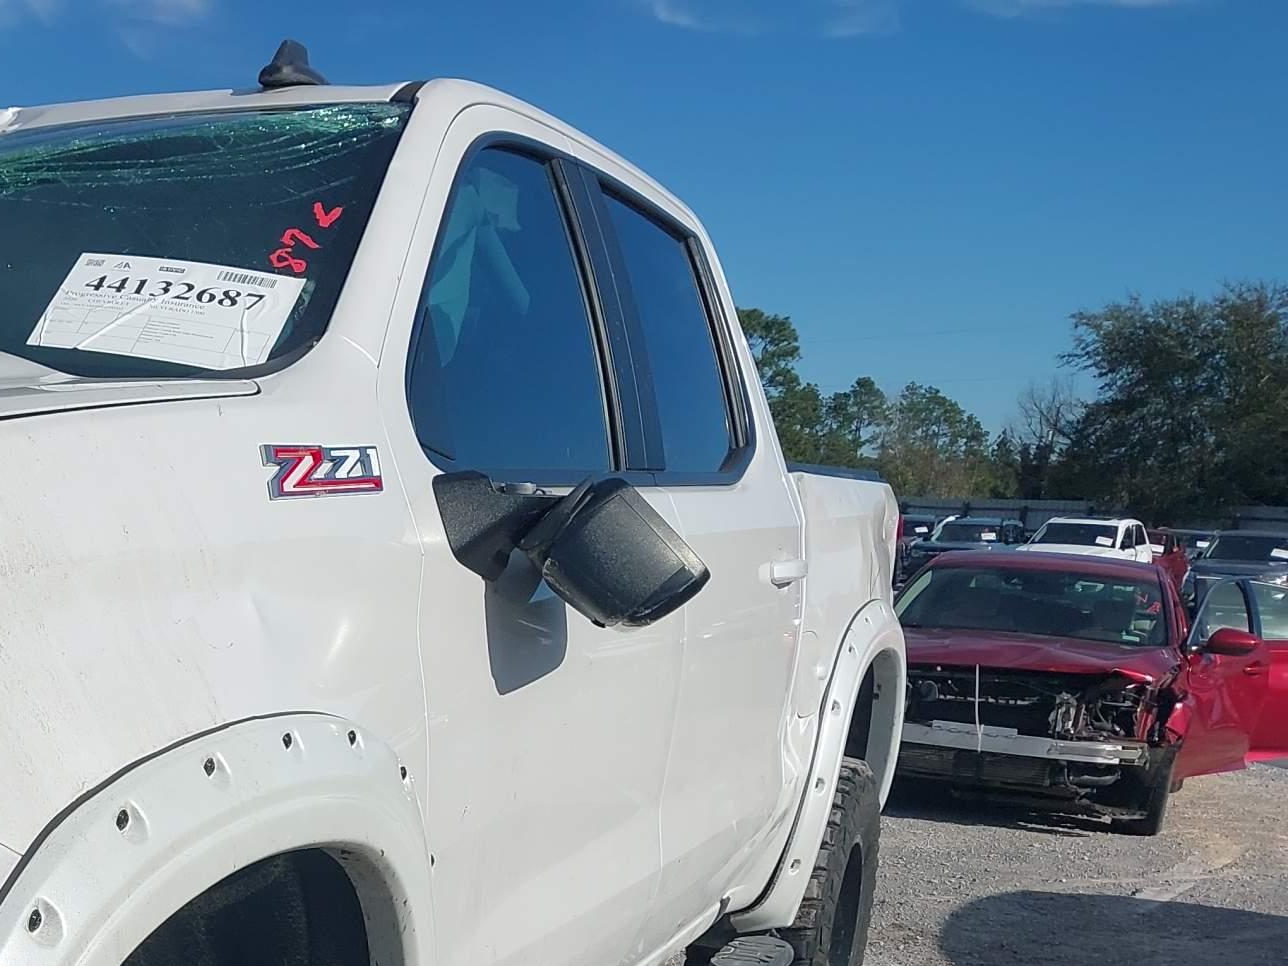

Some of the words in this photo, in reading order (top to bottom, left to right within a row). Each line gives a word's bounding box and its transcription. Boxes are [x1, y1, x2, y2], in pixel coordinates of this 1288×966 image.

[85, 275, 266, 311] 44132687
[160, 298, 205, 310] Insurance
[259, 445, 383, 500] Z71
